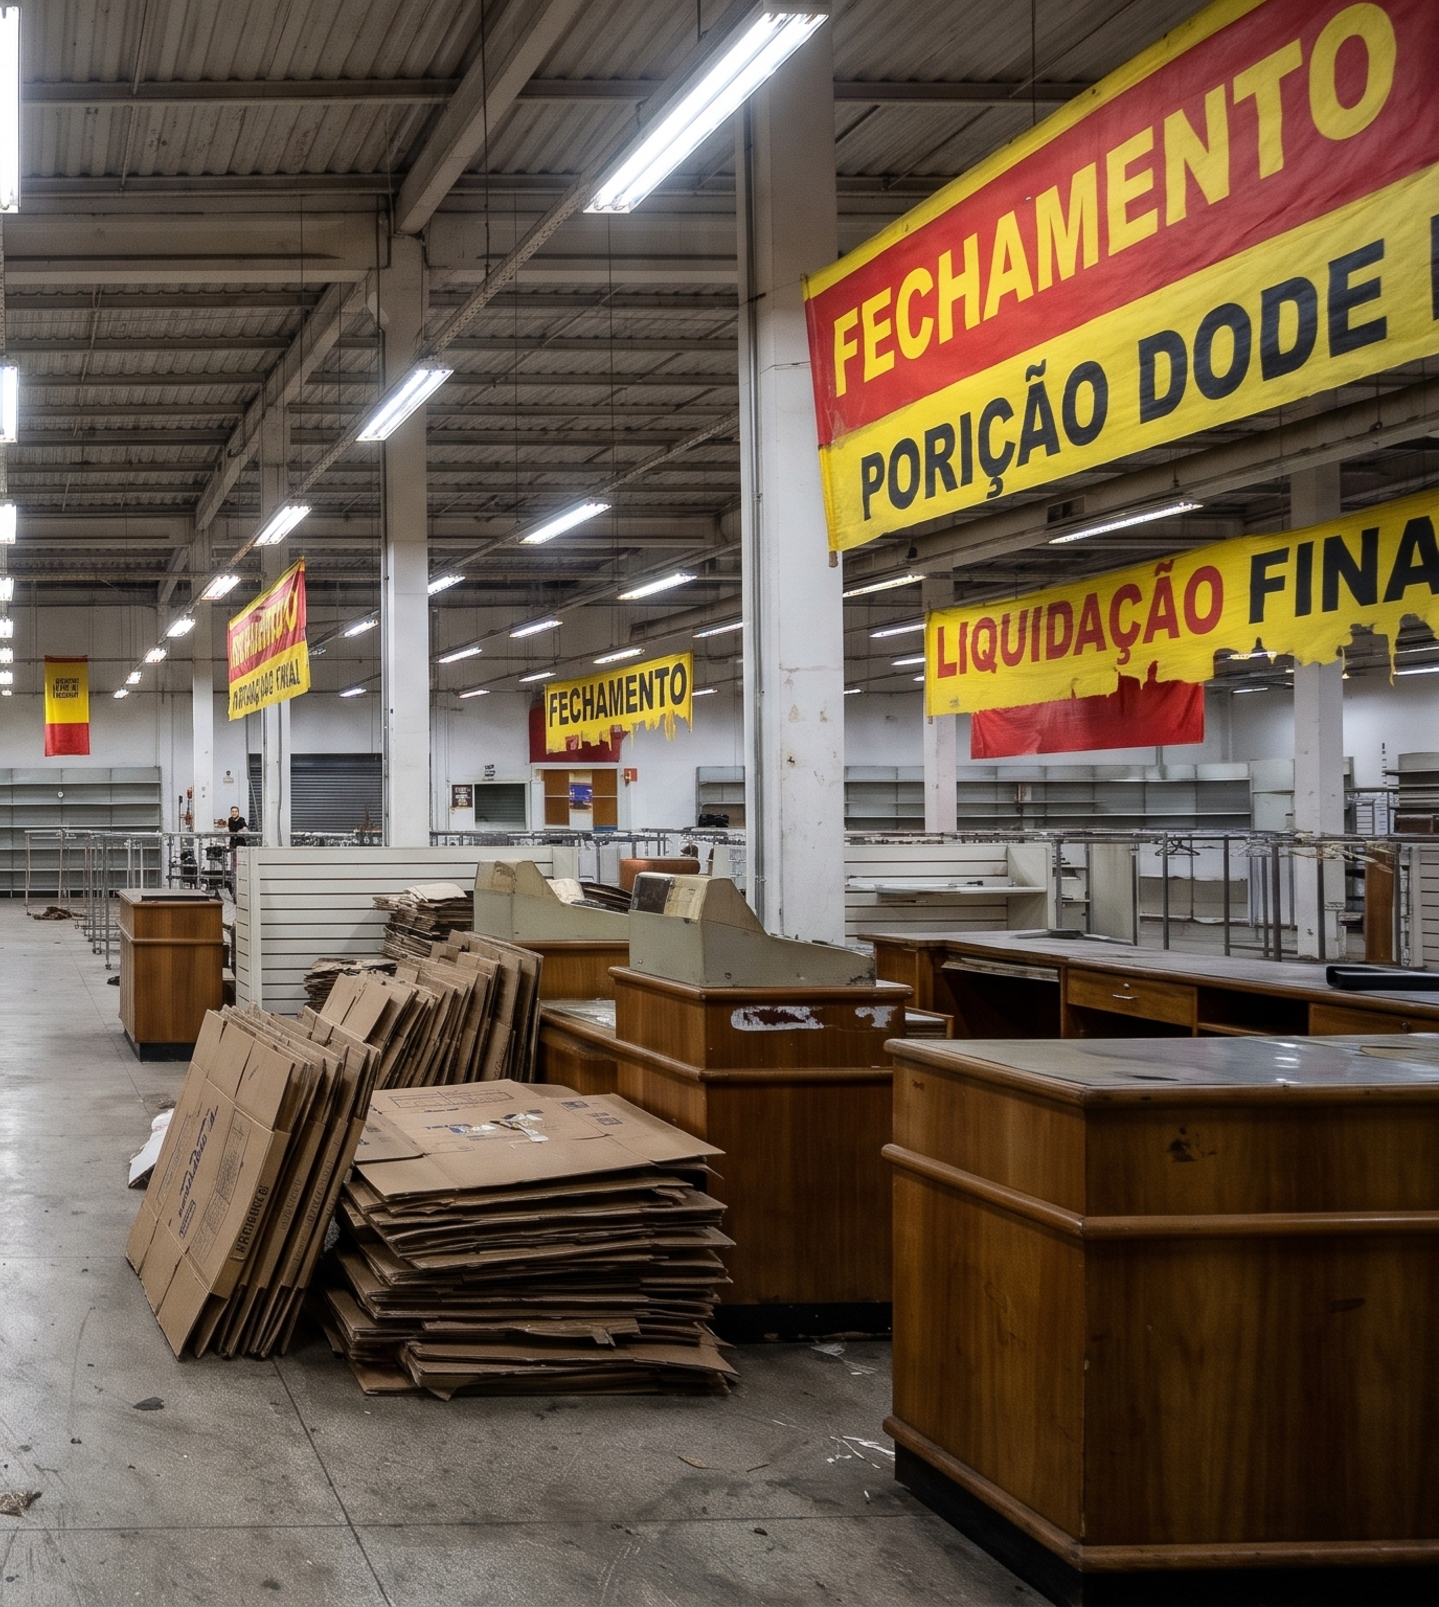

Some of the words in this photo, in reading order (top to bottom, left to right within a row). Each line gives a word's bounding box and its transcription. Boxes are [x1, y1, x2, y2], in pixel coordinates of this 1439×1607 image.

[832, 4, 1397, 398] FECHAMENTO
[861, 359, 1109, 521] PORIÇÃO
[1138, 238, 1388, 425] DODE
[549, 662, 687, 728] FECHAMENTO
[937, 558, 1224, 680] LIQUIDAÇÃO
